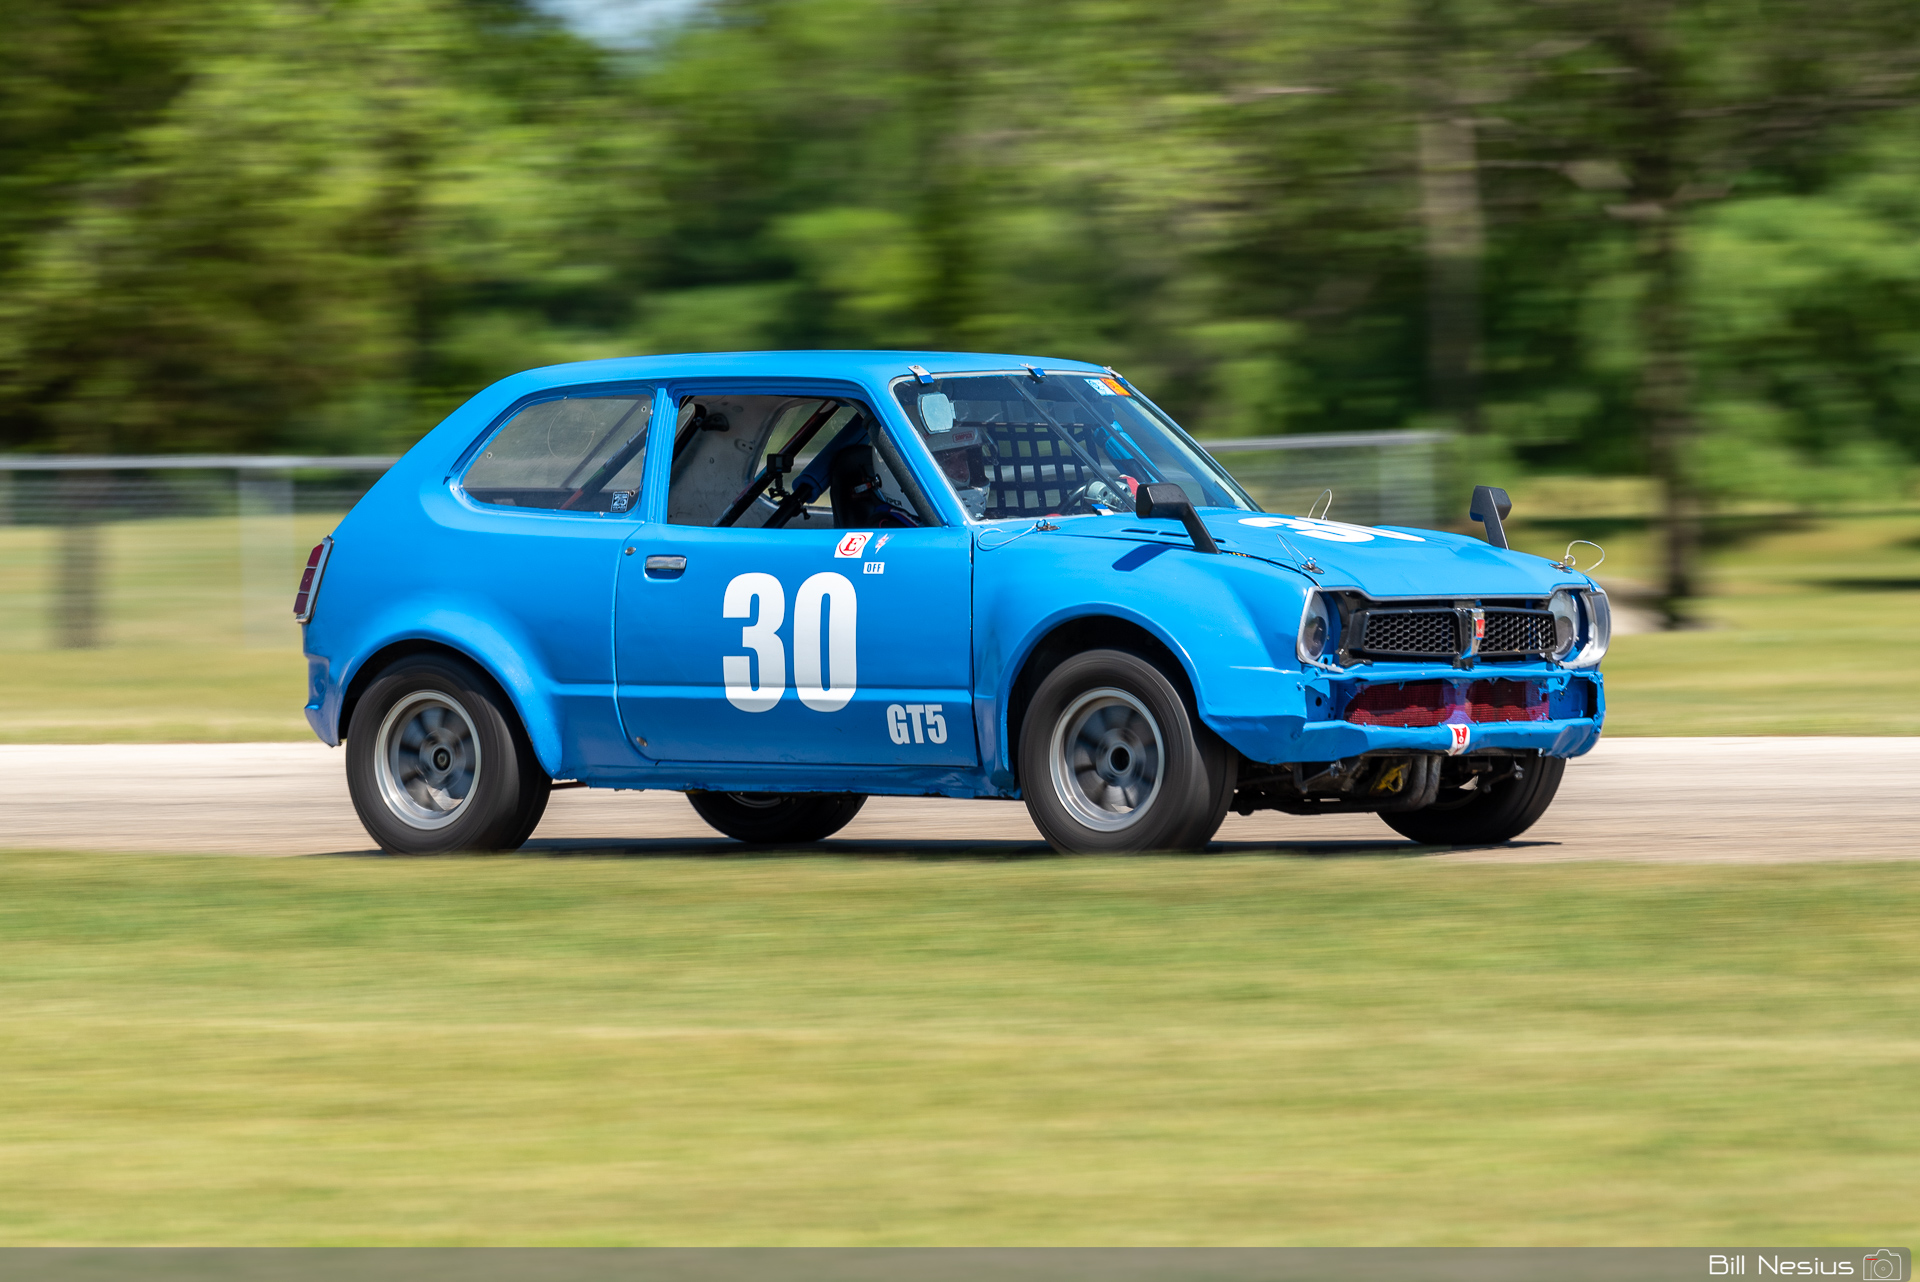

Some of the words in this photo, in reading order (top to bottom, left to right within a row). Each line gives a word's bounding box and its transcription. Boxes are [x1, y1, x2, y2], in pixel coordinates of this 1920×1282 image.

[843, 537, 861, 552] E
[866, 563, 882, 573] OFF
[722, 571, 857, 713] 30
[886, 704, 948, 745] GT5
